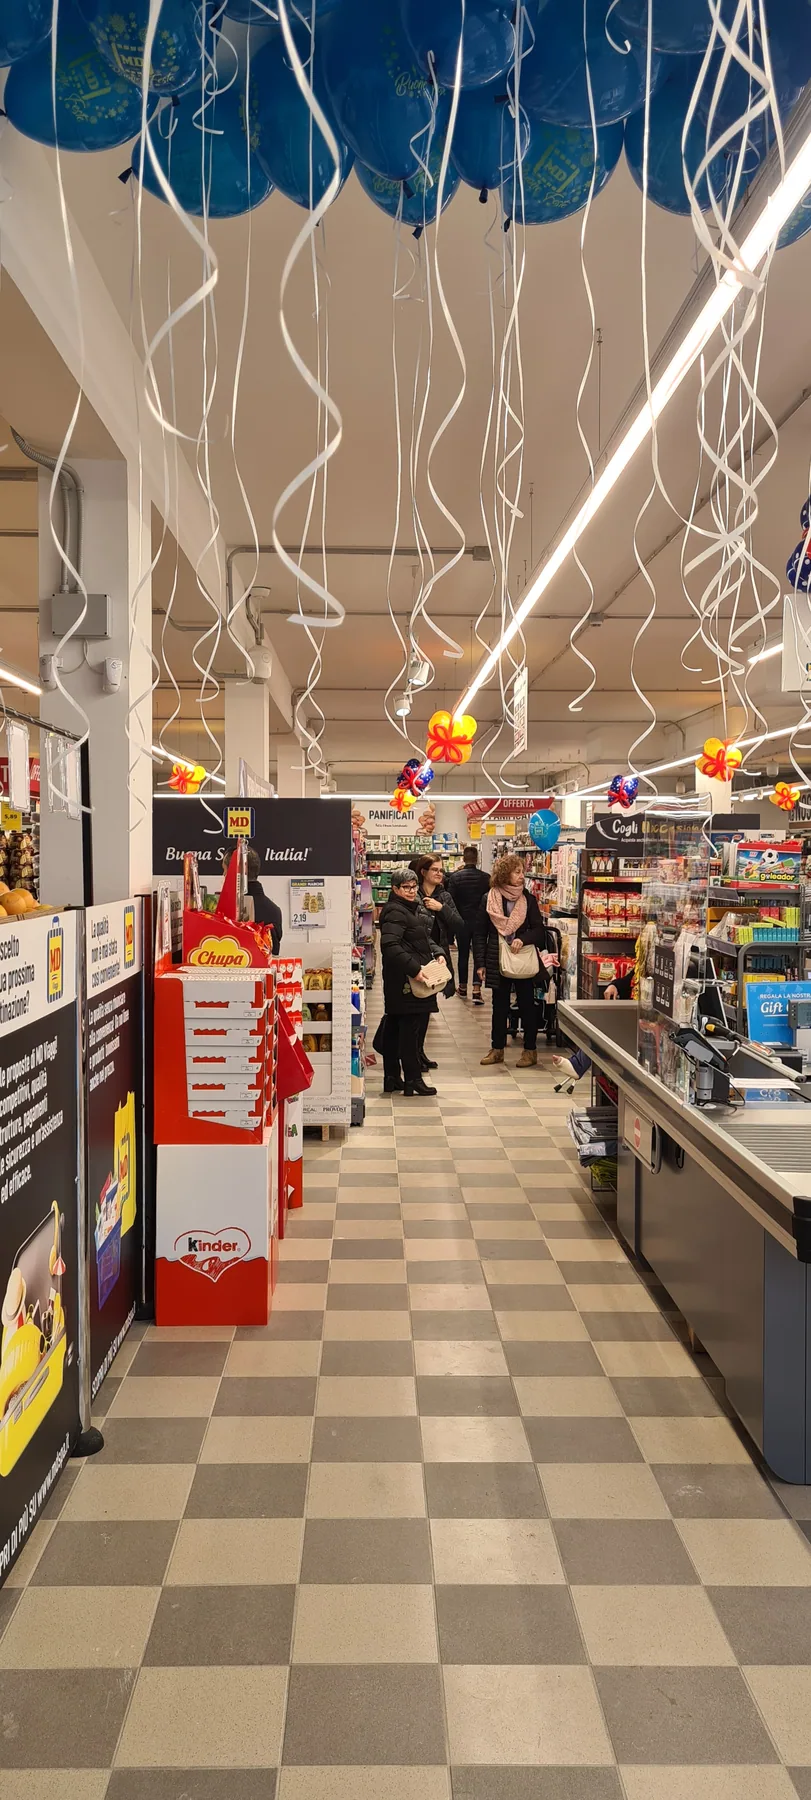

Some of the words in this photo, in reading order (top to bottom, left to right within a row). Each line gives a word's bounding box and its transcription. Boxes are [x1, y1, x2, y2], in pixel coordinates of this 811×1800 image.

[503, 800, 534, 808] OFFERTA
[230, 816, 250, 827] MD
[368, 810, 414, 820] PANIFICATI
[612, 819, 638, 837] Cogli
[264, 848, 308, 862] Italia!
[50, 946, 61, 973] MD
[198, 950, 244, 968] Chupa
[8, 961, 35, 996] prossima
[0, 990, 30, 1024] tinazione?
[760, 1001, 783, 1015] Gift
[6, 1054, 30, 1088] proposte
[31, 1047, 36, 1070] di
[36, 1044, 43, 1066] MD
[0, 1116, 23, 1146] trutture,
[24, 1092, 48, 1132] pagamenti
[5, 1136, 30, 1171] sicurezza
[1, 1180, 8, 1204] ed
[188, 1238, 238, 1252] kinder
[11, 1526, 18, 1556] DI
[19, 1504, 28, 1543] PIÙ
[29, 1492, 37, 1523] SU
